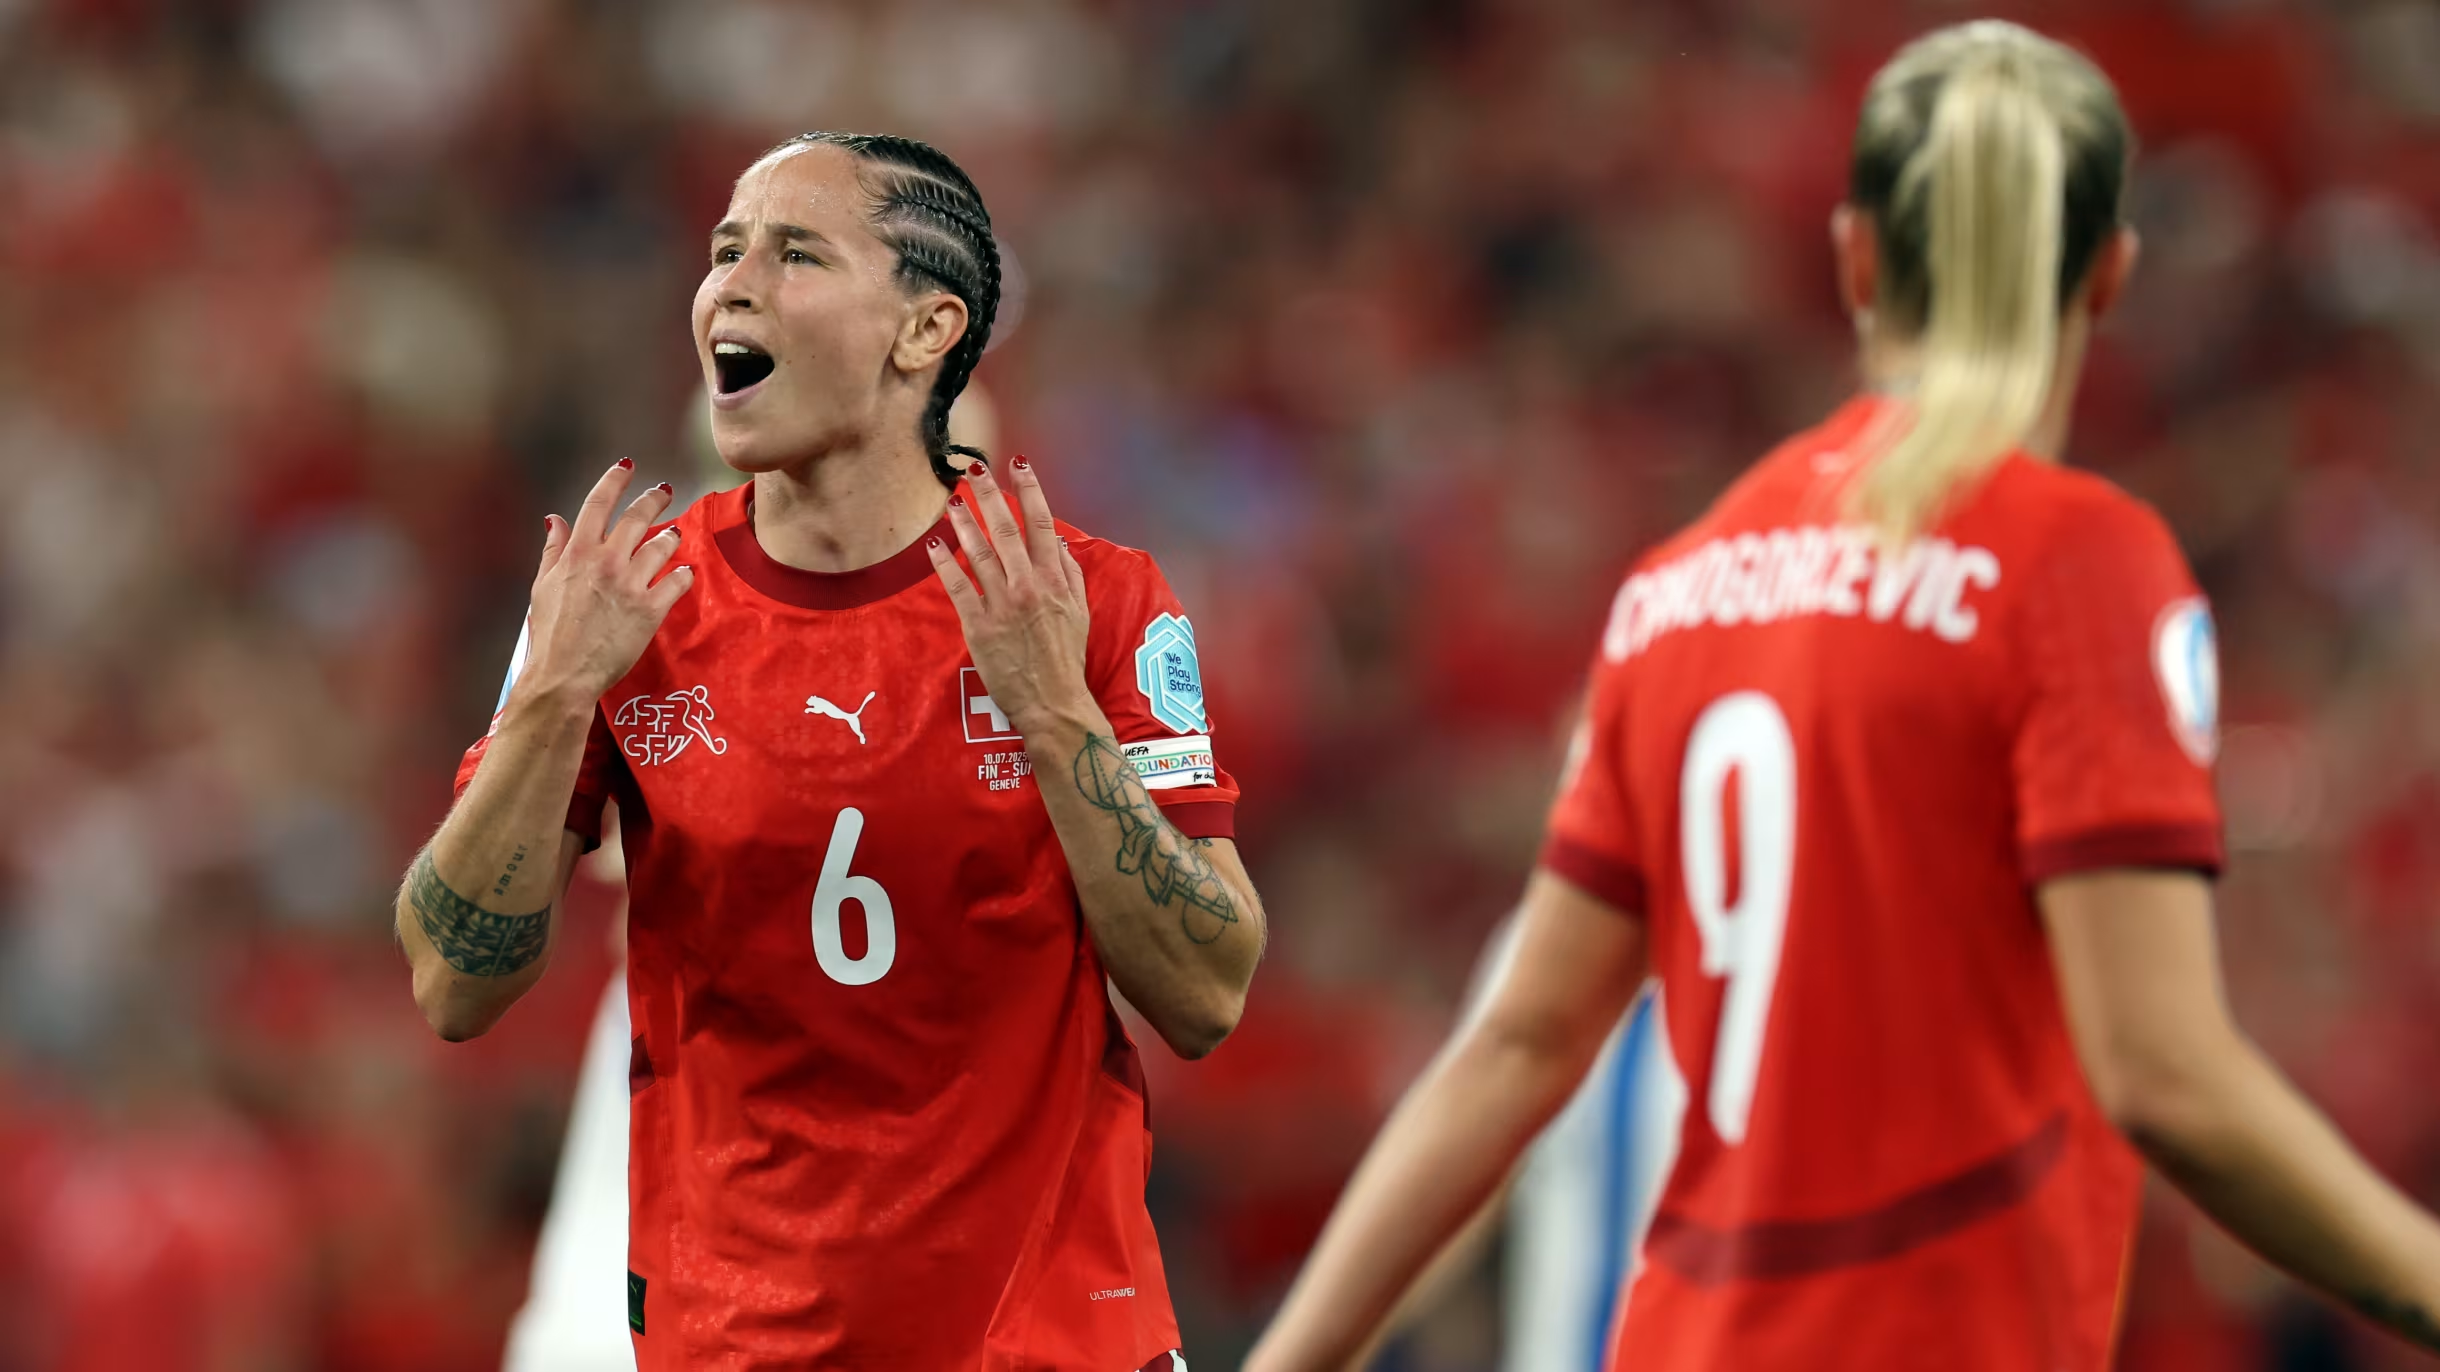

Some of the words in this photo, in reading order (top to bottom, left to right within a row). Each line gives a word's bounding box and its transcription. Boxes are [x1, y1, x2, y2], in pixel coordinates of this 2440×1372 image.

[1165, 652, 1182, 665] We
[1168, 665, 1191, 682] Play
[1124, 746, 1150, 757] UEFA
[1128, 754, 1212, 773] OUNDATIO
[978, 764, 998, 780] FIN
[1193, 771, 1203, 783] for
[989, 778, 1020, 791] GENEVE
[812, 807, 896, 985] 6
[1680, 690, 1797, 1146] 9
